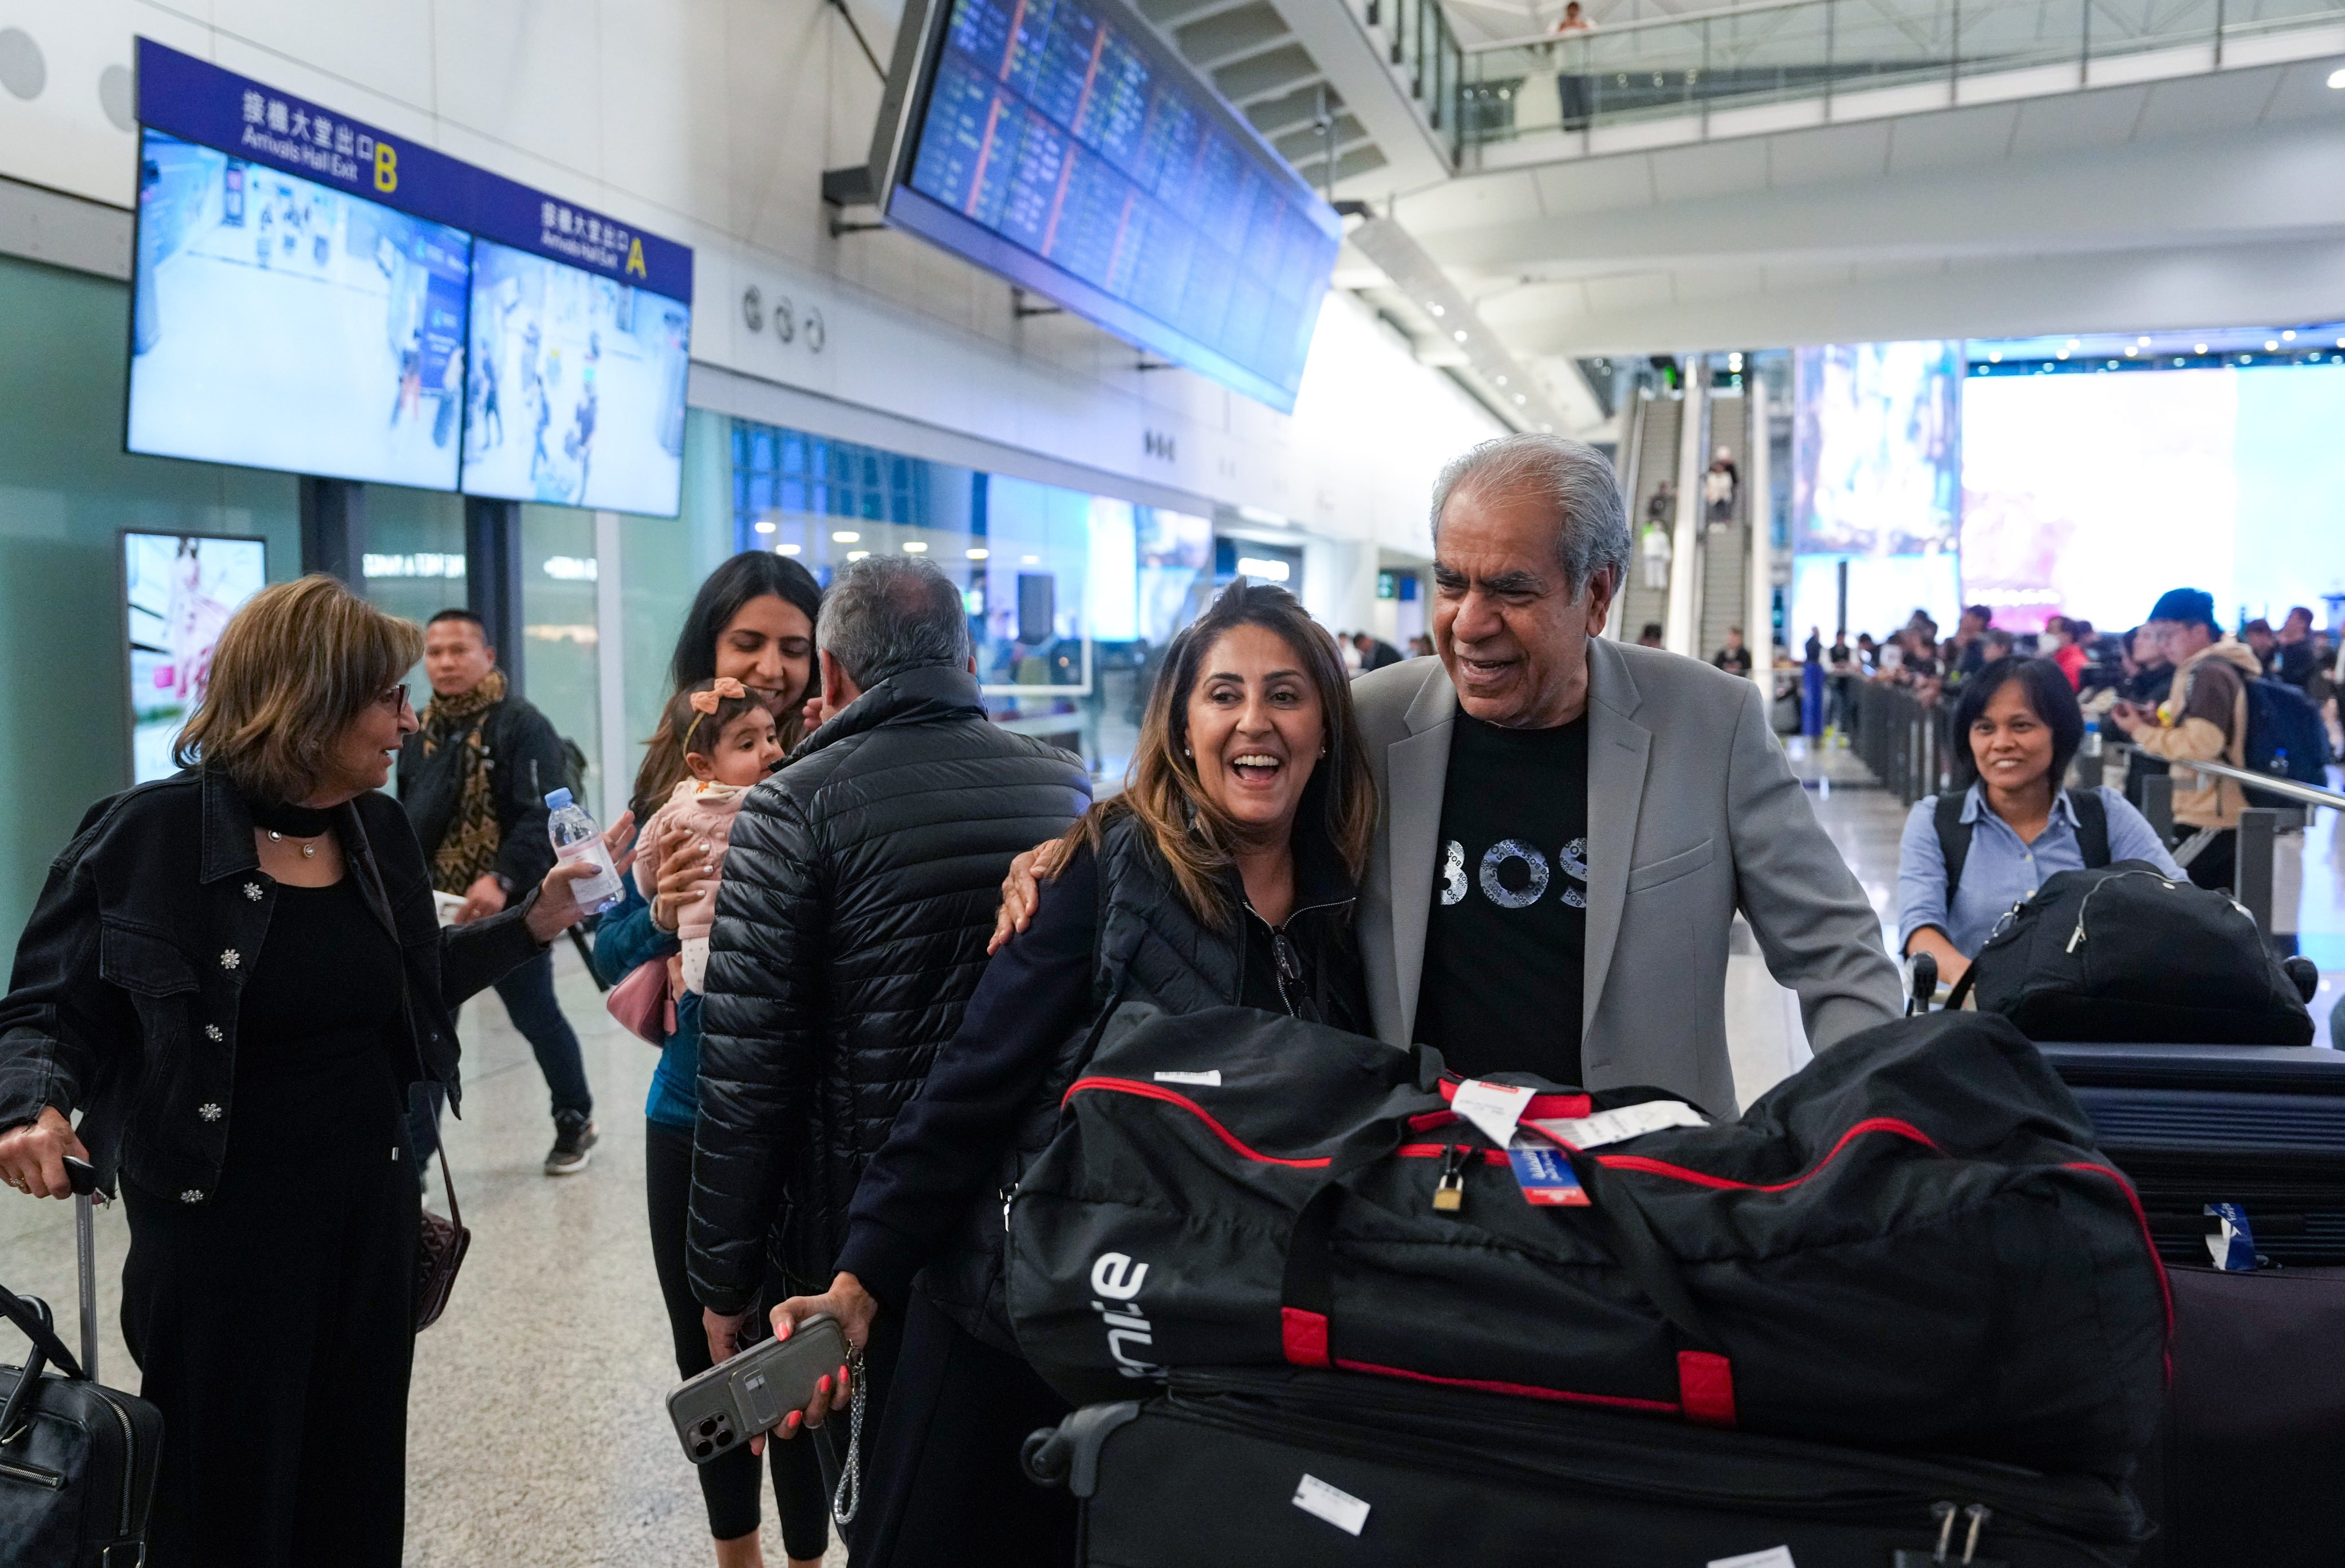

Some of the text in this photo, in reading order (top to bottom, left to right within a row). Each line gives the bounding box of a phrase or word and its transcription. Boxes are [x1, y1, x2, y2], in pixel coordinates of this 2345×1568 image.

[243, 89, 373, 161] 接機大堂出口
[241, 124, 358, 182] Arrivals Hall Exit
[374, 141, 397, 193] B
[625, 237, 647, 279] A
